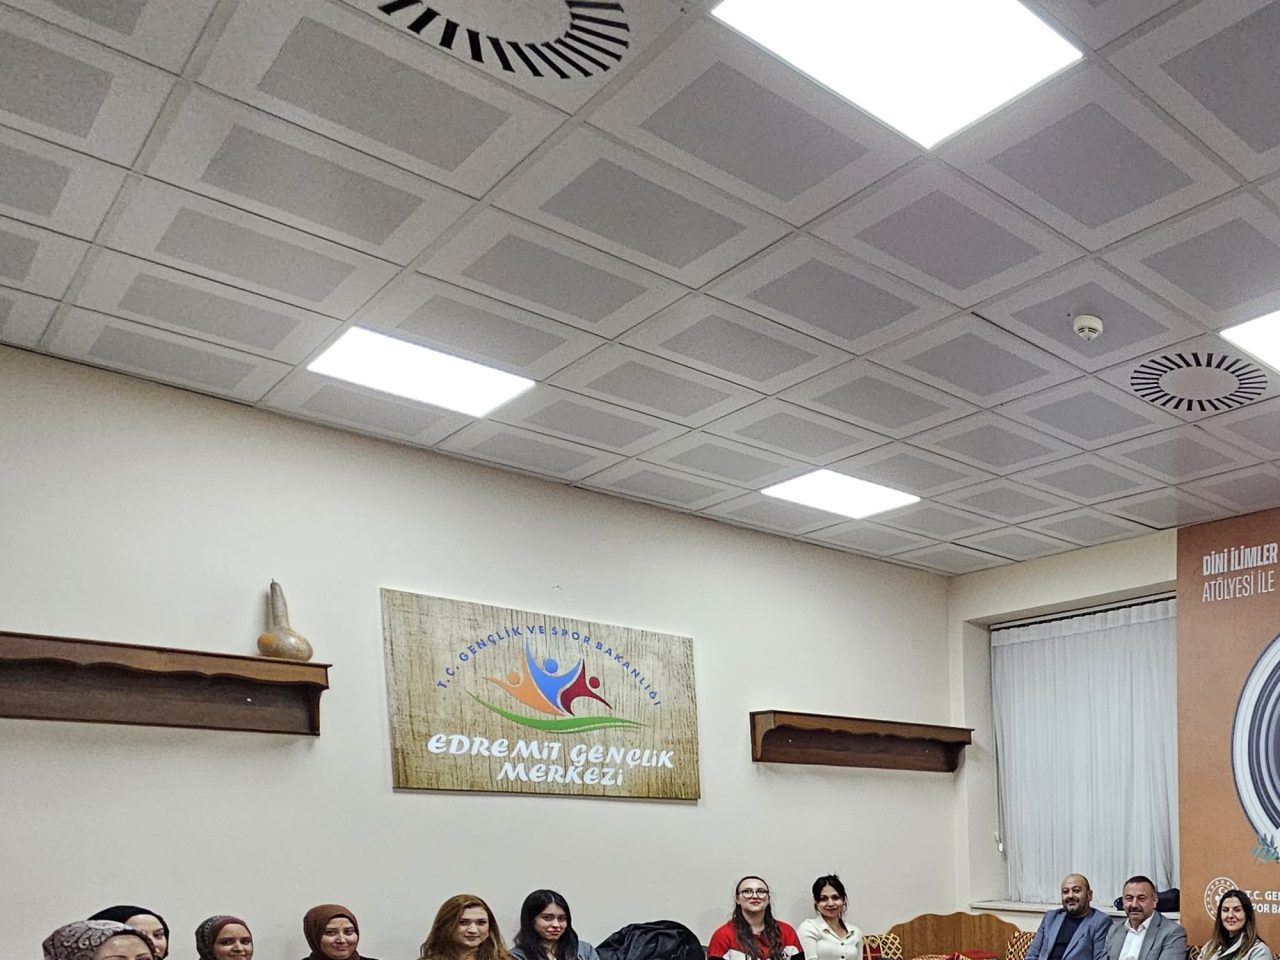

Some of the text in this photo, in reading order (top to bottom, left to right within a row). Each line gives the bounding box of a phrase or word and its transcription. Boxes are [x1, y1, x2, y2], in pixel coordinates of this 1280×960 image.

[1202, 542, 1278, 576] DİNİ İLİMLER
[1202, 569, 1276, 602] ATÖLYESİ İLE
[458, 625, 522, 663] GENÇLİK
[527, 625, 545, 635] VE
[551, 626, 591, 646] SPOR
[594, 640, 662, 707] BAKANLIĞI
[1251, 903, 1270, 913] POR
